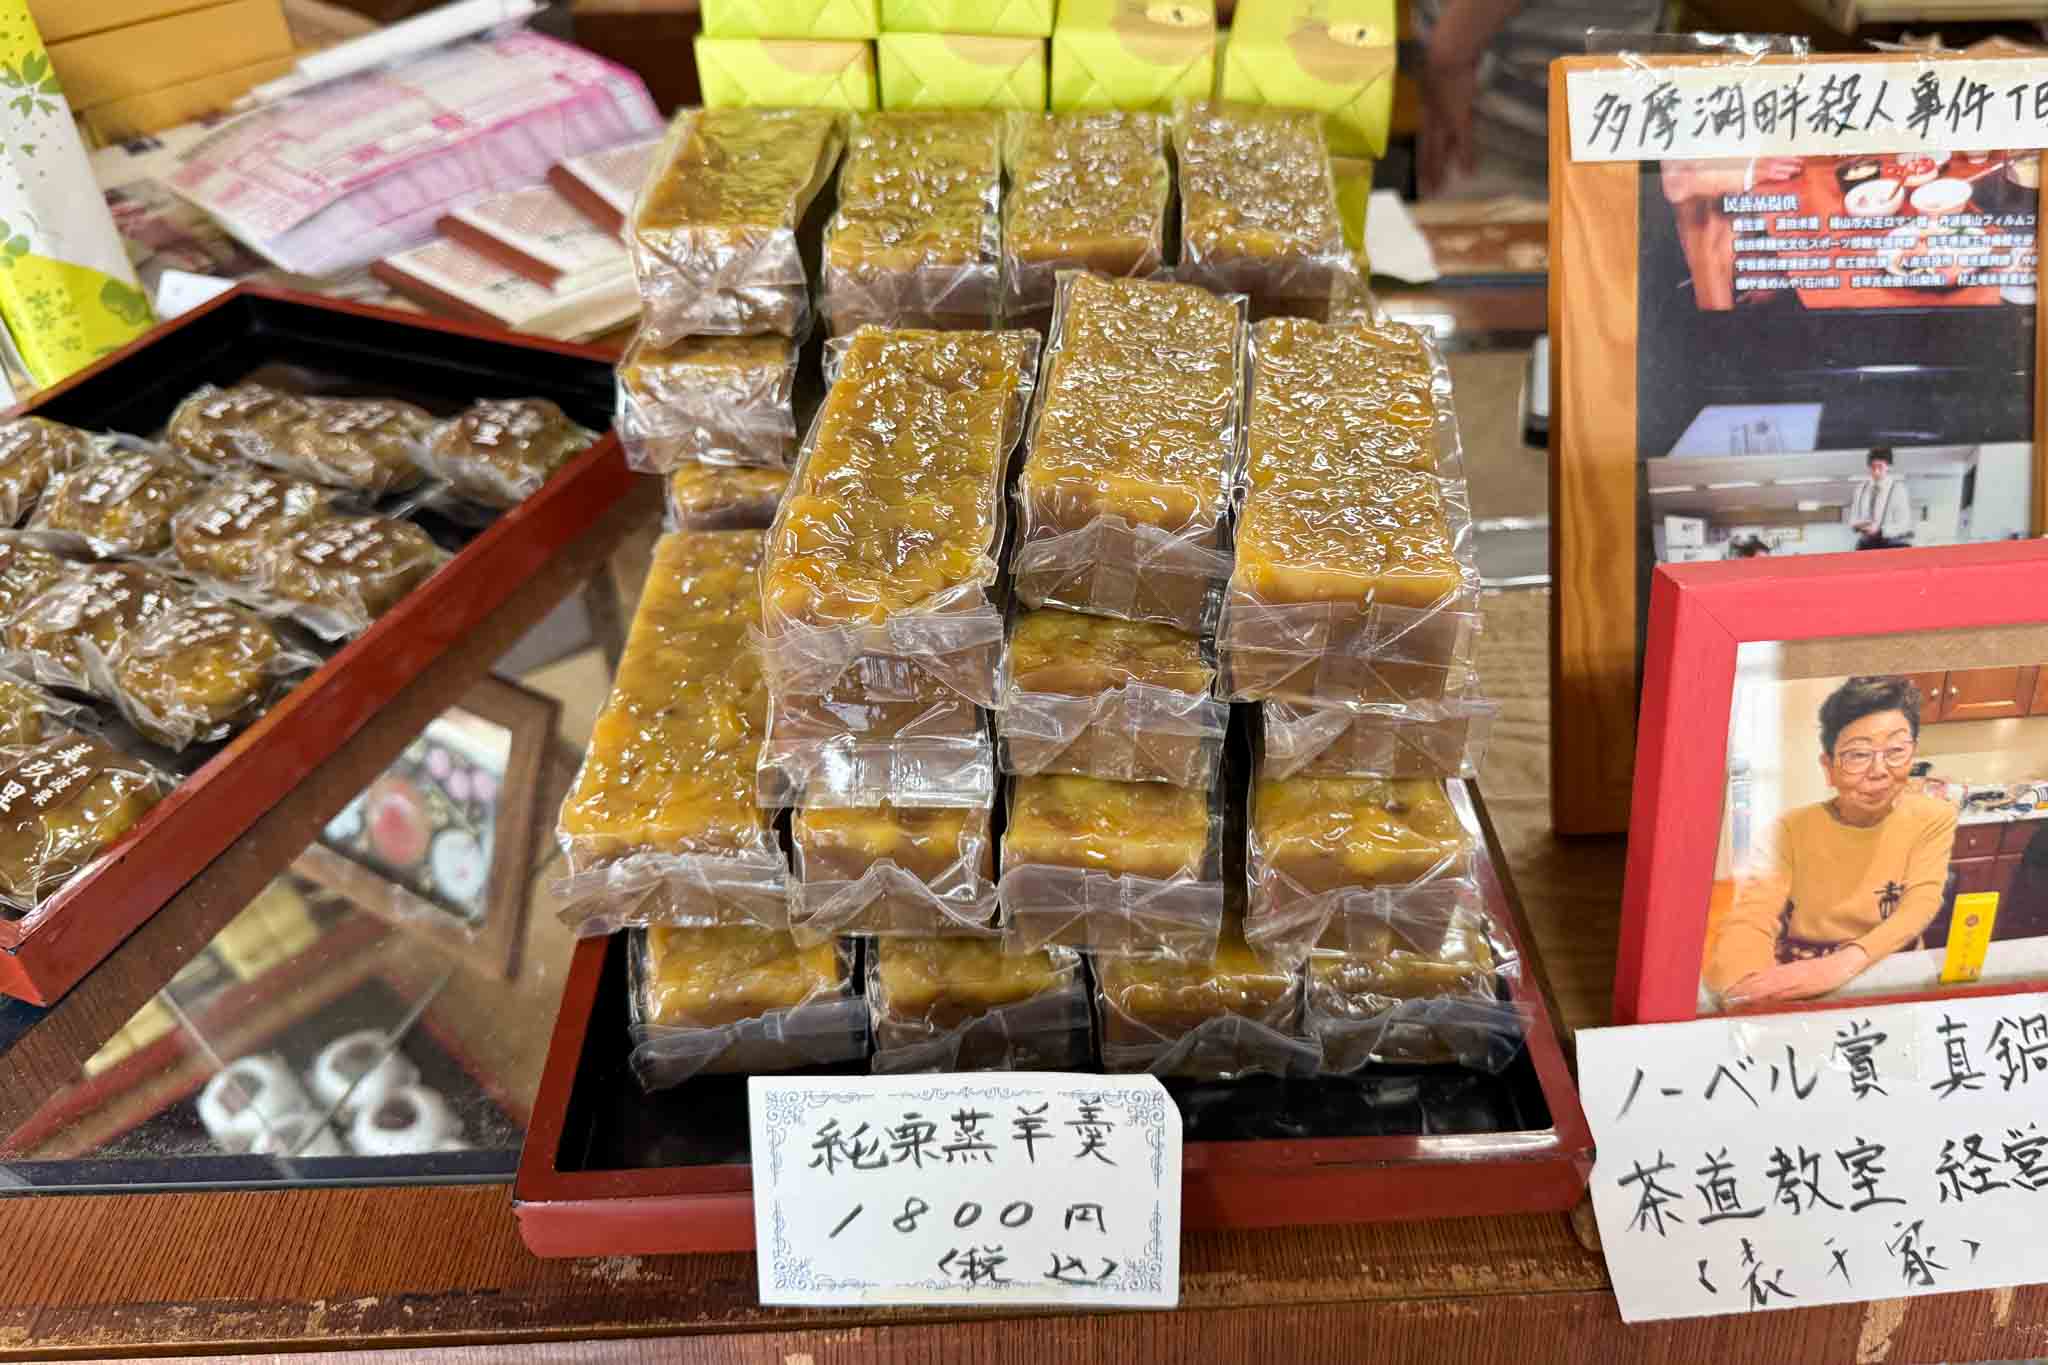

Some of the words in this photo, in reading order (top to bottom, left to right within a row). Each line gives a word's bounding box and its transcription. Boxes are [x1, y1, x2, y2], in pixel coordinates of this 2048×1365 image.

[1615, 1018, 1889, 1121] ノーベル賞
[828, 1196, 1107, 1239] 1800円
[1618, 1136, 1907, 1238] 茶道教室
[1935, 1121, 2048, 1203] 経営
